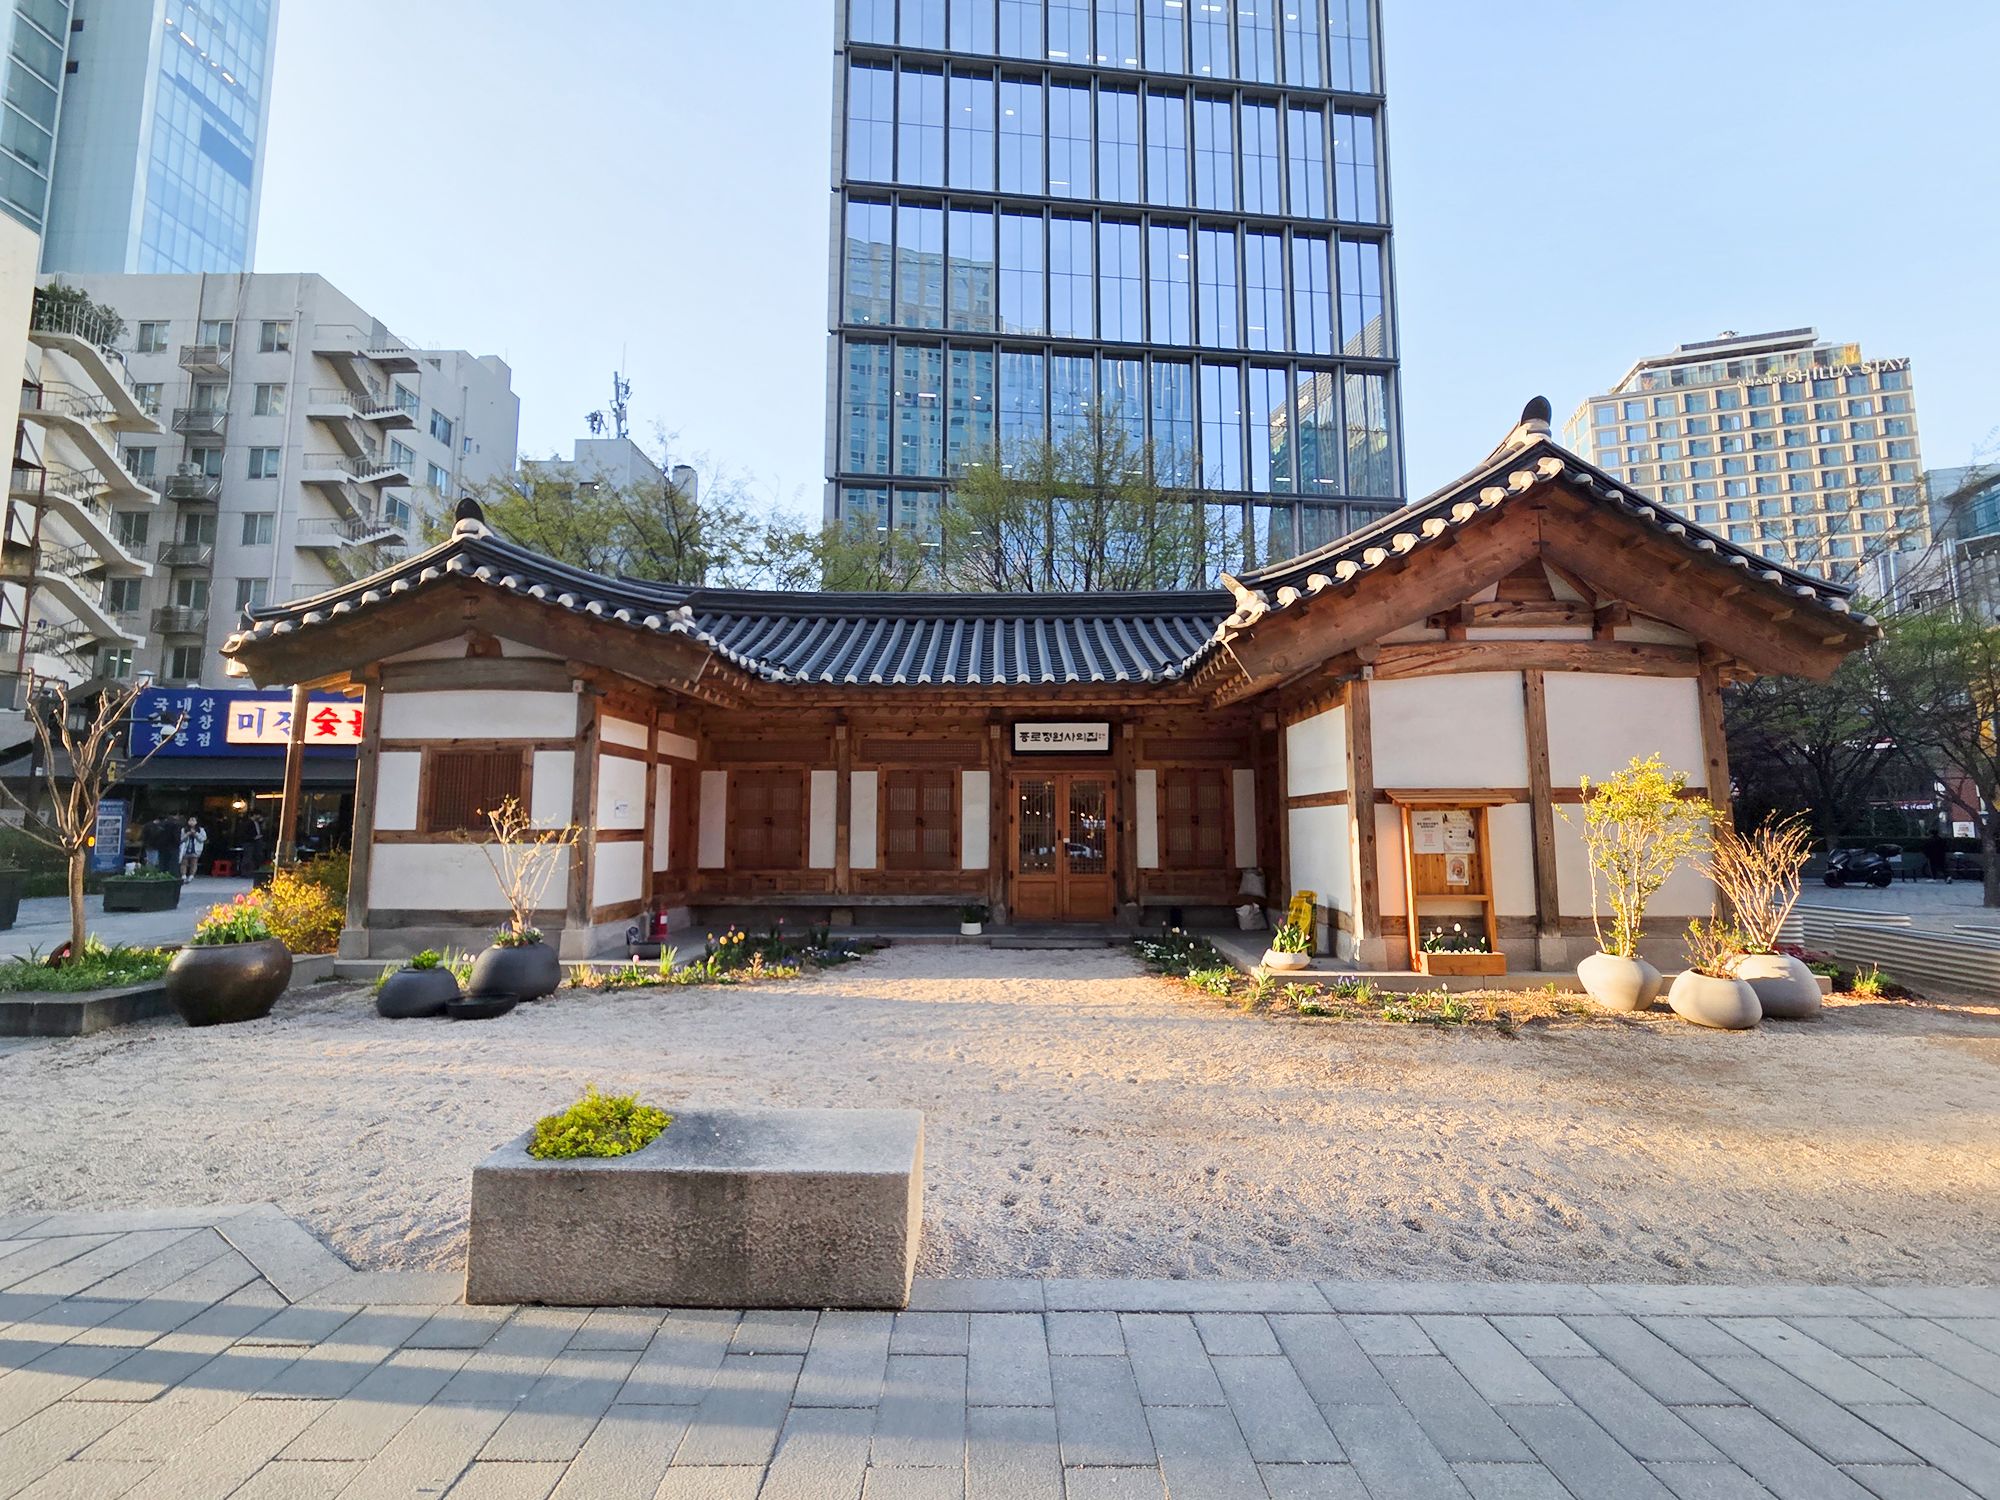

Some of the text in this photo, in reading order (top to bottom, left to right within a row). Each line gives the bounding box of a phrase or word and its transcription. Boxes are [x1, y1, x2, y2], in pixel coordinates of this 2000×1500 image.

[1786, 364, 1853, 384] SHILLA
[1860, 358, 1907, 375] STAY
[153, 697, 215, 712] 국내산
